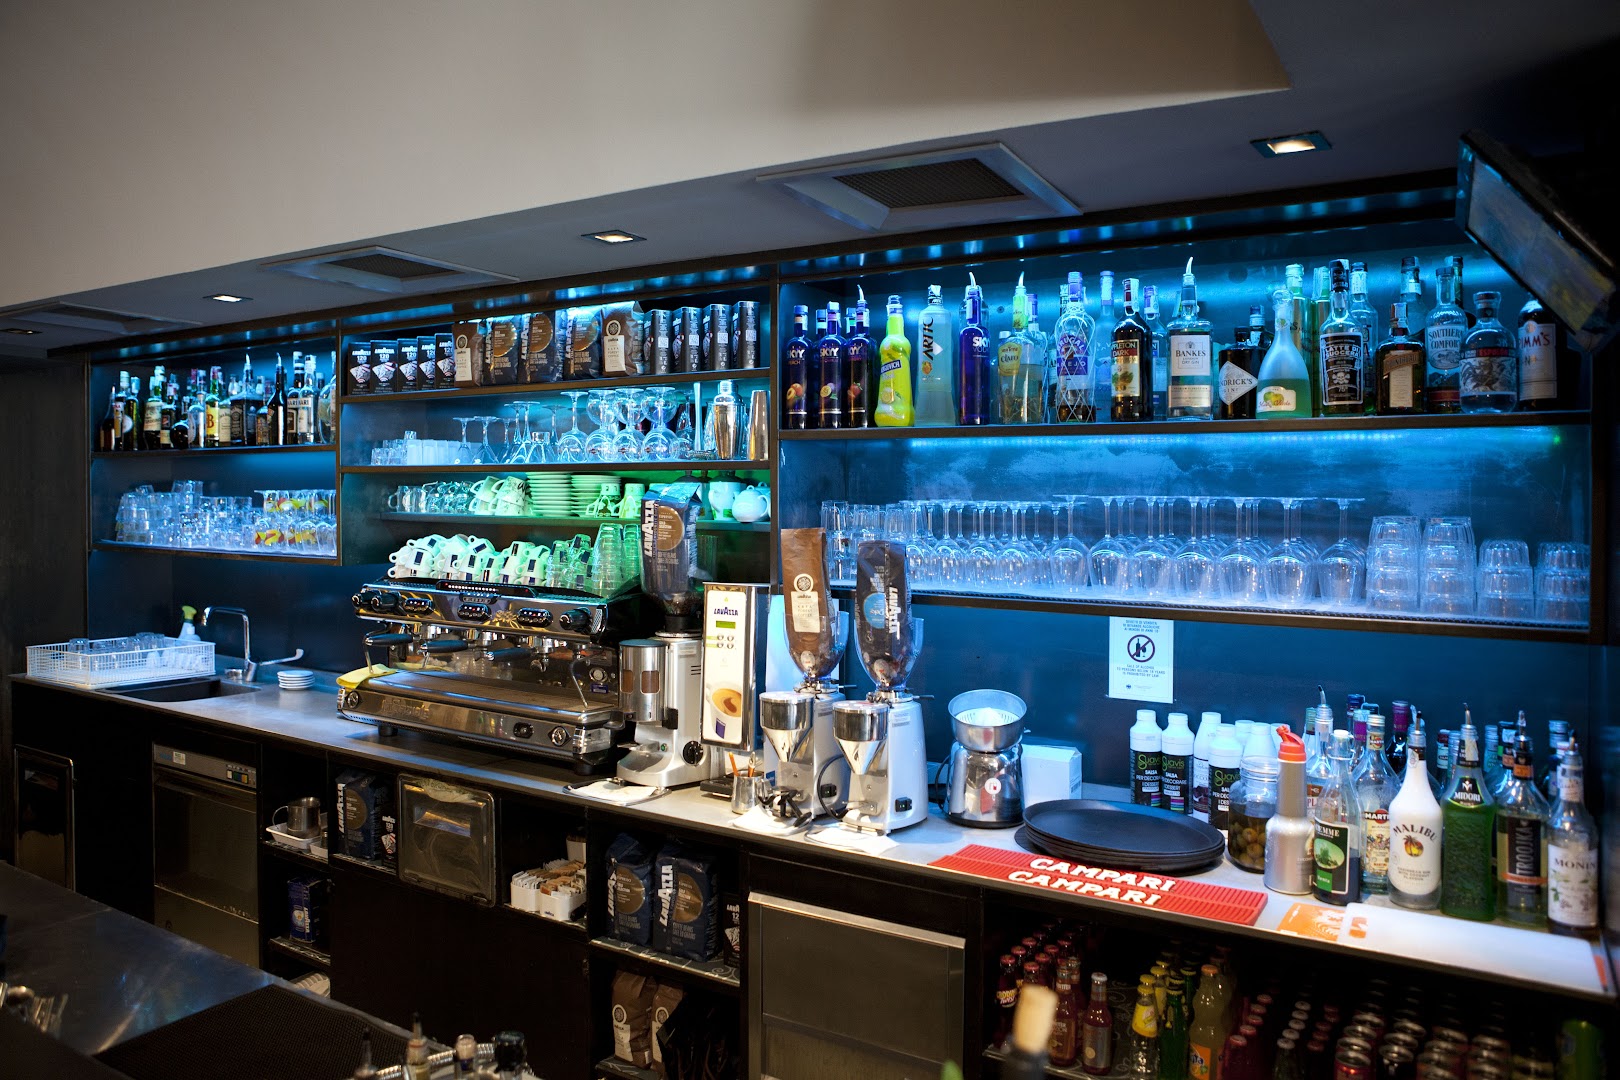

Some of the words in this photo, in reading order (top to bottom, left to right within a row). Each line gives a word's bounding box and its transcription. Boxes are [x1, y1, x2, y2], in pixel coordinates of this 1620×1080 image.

[820, 347, 839, 357] SKYY
[1175, 348, 1207, 358] BANKES
[641, 500, 655, 558] LAVAZZA
[713, 606, 739, 616] LAVAZZA
[888, 586, 902, 634] LAVAZZA
[1453, 791, 1481, 802] MIDORI
[1392, 823, 1438, 842] MALIBU
[1554, 857, 1596, 870] MONIN
[1029, 858, 1176, 892] CAMPARI
[657, 864, 673, 927] LAVAZZA
[1007, 870, 1162, 905] CAMPARI
